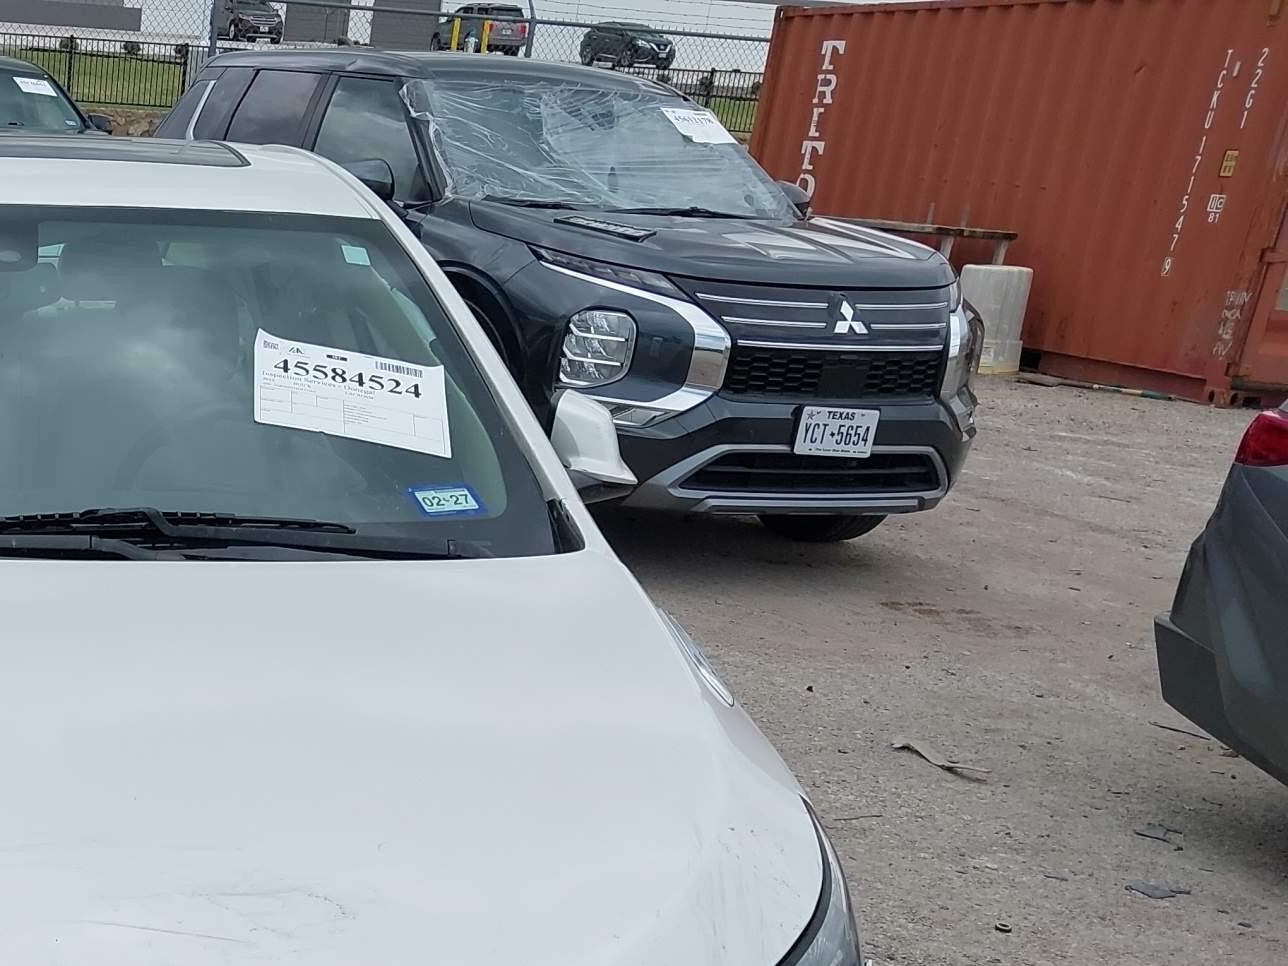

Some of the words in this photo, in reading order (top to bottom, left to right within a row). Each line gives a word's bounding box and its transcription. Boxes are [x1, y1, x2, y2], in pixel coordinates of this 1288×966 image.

[1204, 49, 1233, 129] TCKU
[1240, 47, 1270, 129] 22G1
[1171, 135, 1206, 251] 171547
[1208, 212, 1220, 223] 81
[1161, 256, 1173, 276] 9
[273, 357, 423, 399] 45584524
[827, 410, 857, 421] TEXAS
